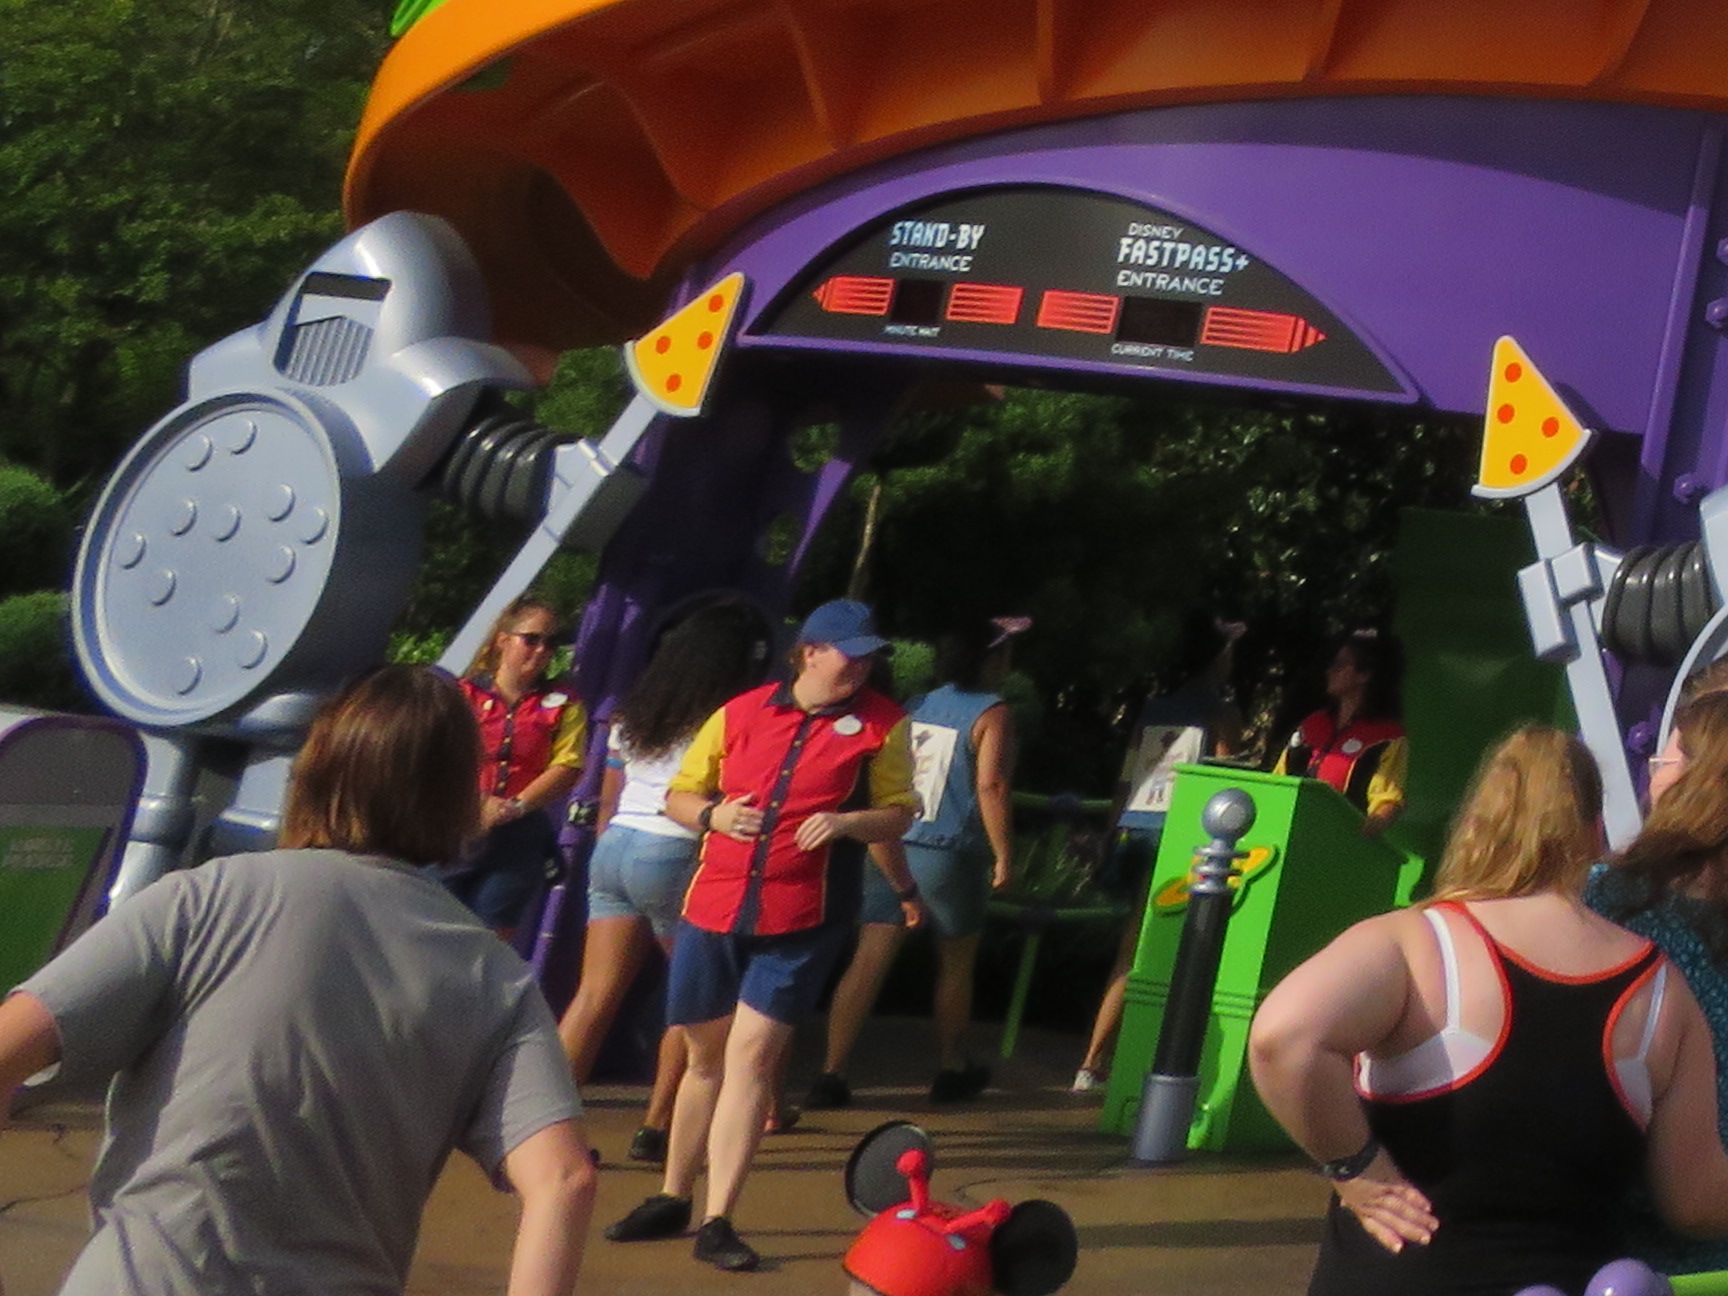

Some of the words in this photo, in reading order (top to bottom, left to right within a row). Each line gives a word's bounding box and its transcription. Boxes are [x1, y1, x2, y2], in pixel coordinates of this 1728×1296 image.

[889, 220, 986, 250] STAND-BY
[1127, 222, 1184, 239] DISNEY
[889, 251, 973, 272] ENTRANCE
[1117, 237, 1250, 273] FASTPASS+
[1117, 269, 1225, 296] ENTRANCE
[1166, 348, 1194, 362] TIME
